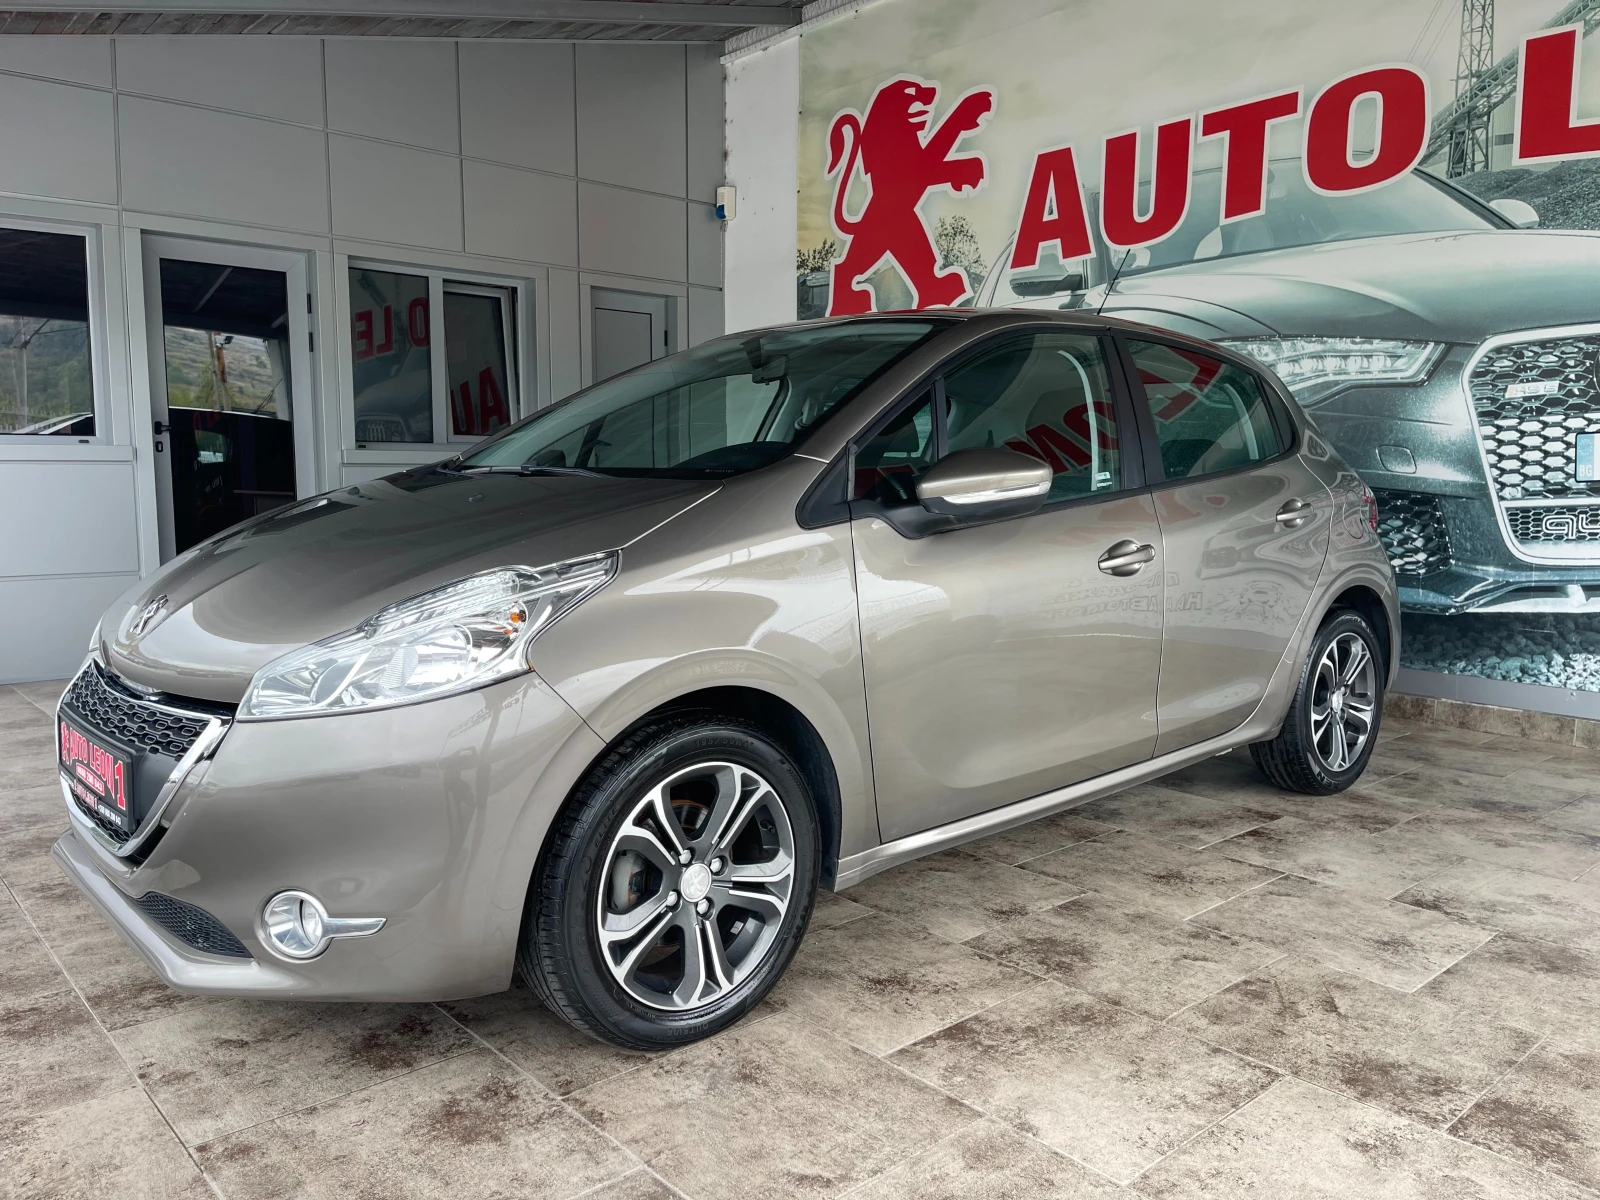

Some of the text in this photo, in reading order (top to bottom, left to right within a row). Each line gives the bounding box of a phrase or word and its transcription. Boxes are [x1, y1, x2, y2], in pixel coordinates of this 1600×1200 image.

[1008, 64, 1429, 272] AUTO
[1579, 465, 1593, 477] BG
[69, 727, 126, 811] AUTO LEON 1
